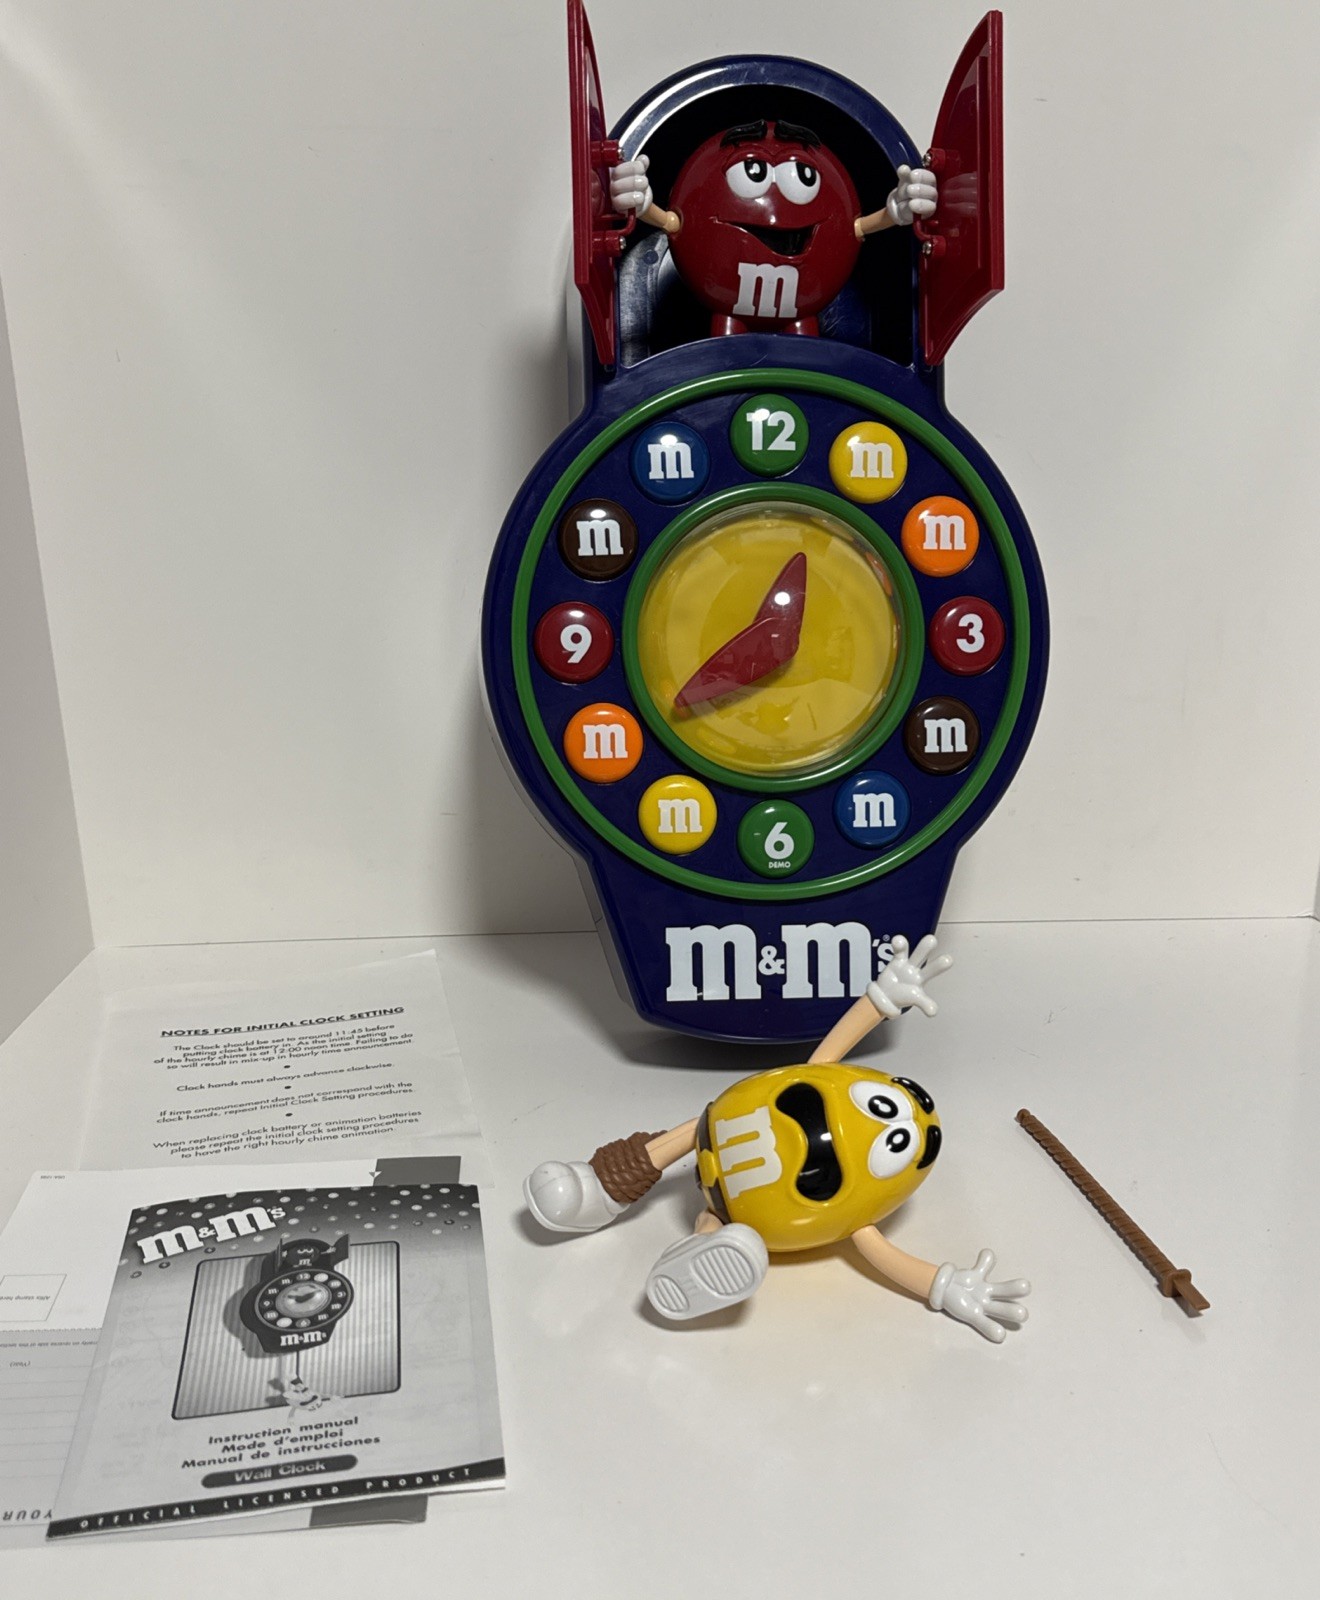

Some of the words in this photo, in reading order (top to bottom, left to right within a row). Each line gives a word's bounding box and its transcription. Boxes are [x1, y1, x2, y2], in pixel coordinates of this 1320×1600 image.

[732, 262, 799, 318] m
[746, 410, 796, 451] 12
[647, 439, 694, 480] m
[850, 440, 894, 479] m
[576, 517, 624, 557] m
[922, 515, 967, 550] m
[560, 624, 592, 664] 9
[956, 613, 985, 654] 3
[582, 723, 629, 760] m
[924, 717, 968, 753] m
[657, 797, 703, 834] m
[852, 792, 896, 828] m
[764, 822, 795, 860] 6
[768, 861, 791, 869] DEMO
[161, 1028, 209, 1036] NOTES
[214, 1026, 242, 1034] FOR
[247, 1021, 297, 1031] INITIAL
[300, 1015, 345, 1026] CLOCK
[350, 1006, 404, 1019] SETTING
[223, 1040, 255, 1049] should
[298, 1032, 333, 1040] around
[365, 1024, 395, 1033] before
[182, 1050, 217, 1058] putting
[246, 1043, 279, 1052] battery
[357, 1031, 387, 1040] setting
[184, 1055, 216, 1063] hourly
[218, 1052, 247, 1060] chime
[355, 1036, 388, 1045] Failing
[241, 1056, 275, 1064] mix-up
[289, 1048, 319, 1058] hourly
[176, 1084, 205, 1092] Clock
[208, 1080, 239, 1088] hands
[266, 1074, 301, 1083] always
[303, 1069, 345, 1078] advance
[194, 1099, 270, 1113] announcement
[316, 1085, 372, 1097] correspond
[374, 1082, 395, 1090] with
[224, 1107, 258, 1115] repeat
[260, 1101, 288, 1109] Initial
[291, 1097, 319, 1105] Clock
[321, 1092, 356, 1101] Setting
[153, 1140, 186, 1148] When
[189, 1132, 239, 1144] replacing
[241, 1127, 268, 1136] clock
[271, 1122, 308, 1132] battery
[325, 1116, 377, 1126] animation
[379, 1110, 422, 1120] batteries
[170, 1145, 206, 1155] please
[209, 1138, 243, 1148] repeat
[265, 1130, 294, 1139] initial
[297, 1127, 326, 1136] clock
[326, 1123, 360, 1132] setting
[362, 1117, 419, 1130] procedures
[195, 1148, 221, 1157] have
[243, 1140, 269, 1149] right
[271, 1135, 305, 1145] hourly
[307, 1133, 339, 1143] chime
[208, 1426, 291, 1445] Instruction
[299, 1416, 359, 1432] manual
[221, 1441, 266, 1453] Mode
[273, 1429, 344, 1447] d'emploi
[181, 1454, 243, 1468] Manual
[250, 1449, 270, 1460] de
[278, 1436, 381, 1456] instrucciones
[235, 1468, 272, 1482] Wall
[279, 1461, 326, 1475] Clock
[80, 1505, 195, 1529] OFFICIAL
[223, 1486, 339, 1509] LICENSED
[366, 1468, 469, 1489] PRODUCT
